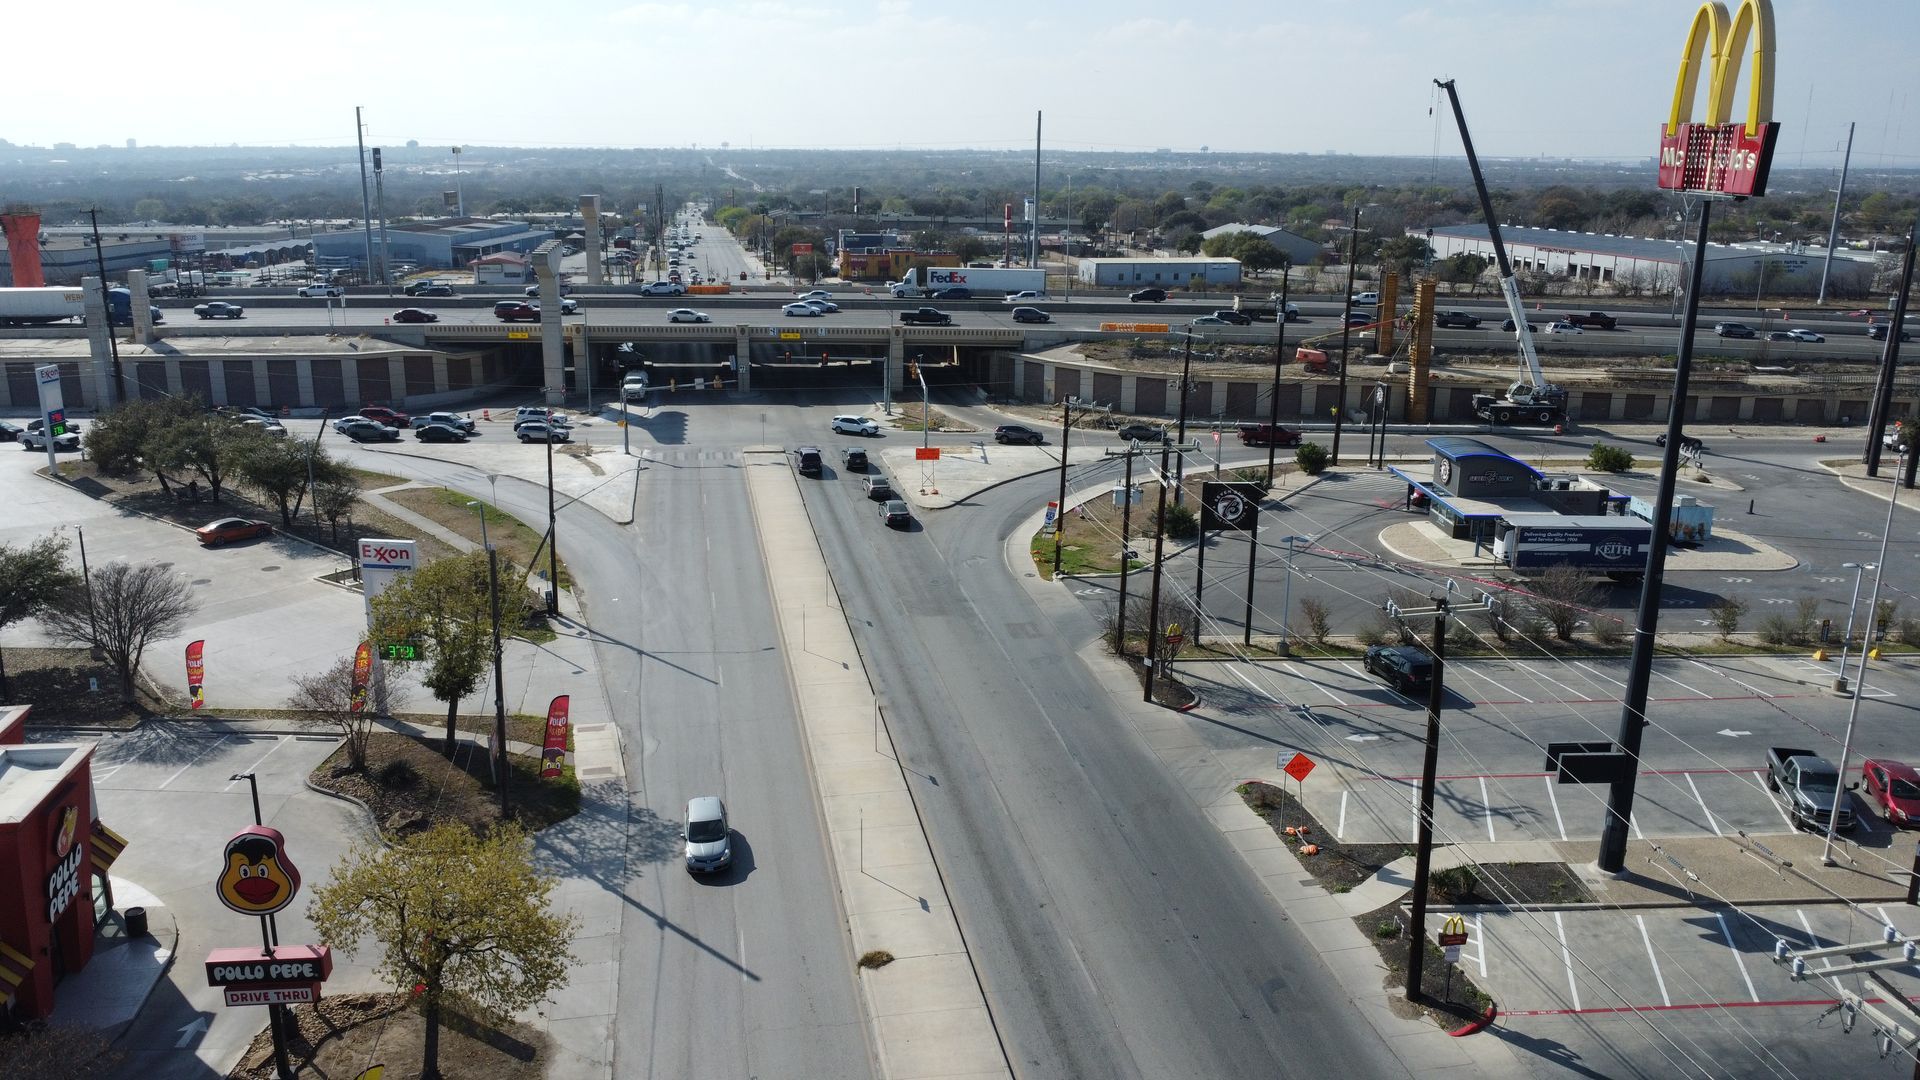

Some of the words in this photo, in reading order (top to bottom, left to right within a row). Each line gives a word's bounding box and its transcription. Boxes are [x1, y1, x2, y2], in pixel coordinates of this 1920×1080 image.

[930, 271, 967, 284] FedEx
[362, 544, 410, 563] Exxon
[1594, 544, 1632, 556] KEITH
[549, 717, 567, 727] POLLO
[49, 842, 82, 899] POLLO
[213, 965, 265, 981] POLLO
[230, 991, 270, 1003] DRIVE
[274, 990, 309, 1002] THRU
